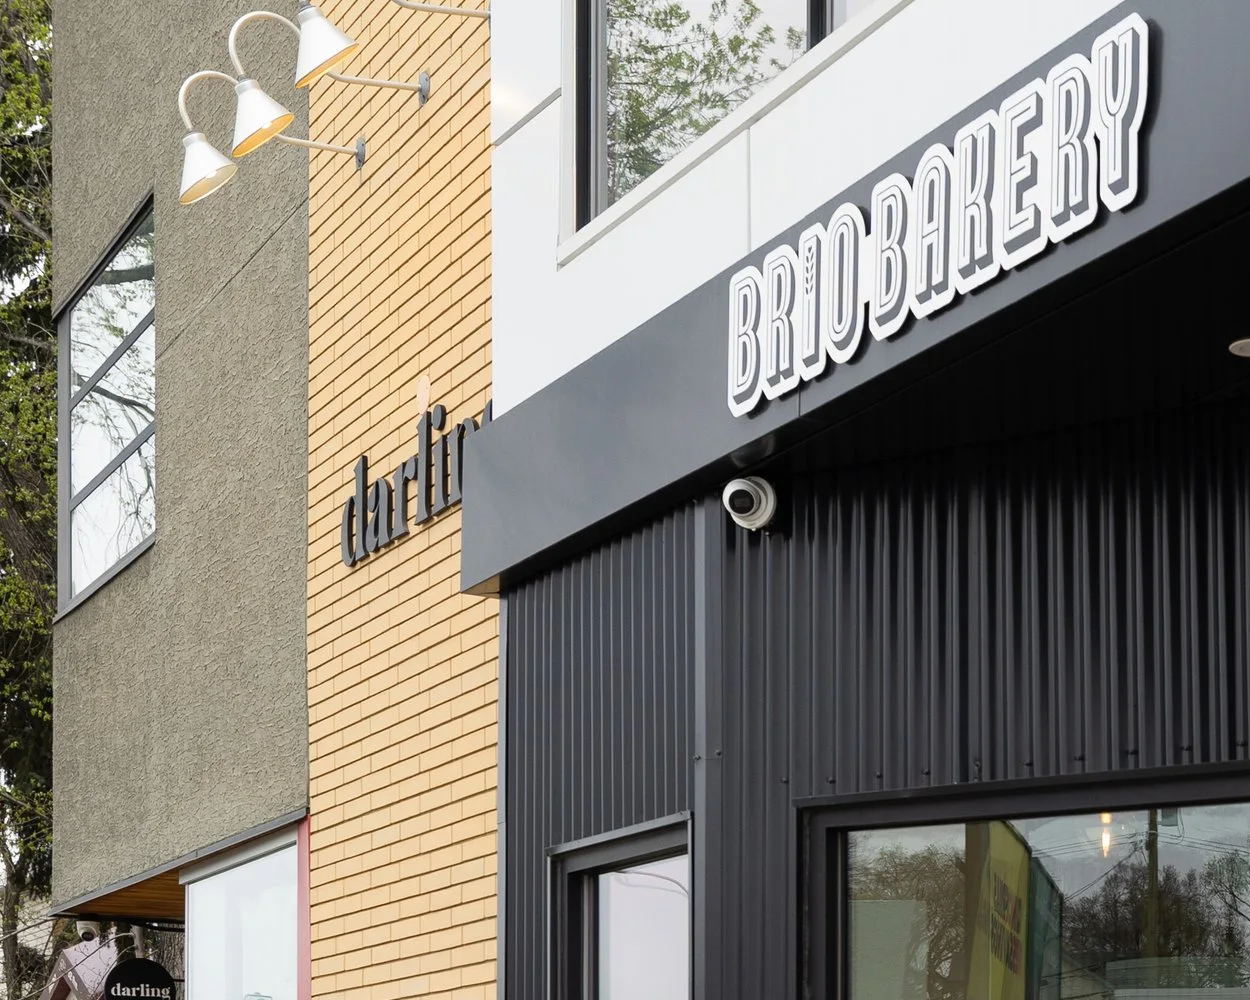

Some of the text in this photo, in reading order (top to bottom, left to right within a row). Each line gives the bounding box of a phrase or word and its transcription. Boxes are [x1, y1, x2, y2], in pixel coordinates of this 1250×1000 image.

[727, 12, 1148, 417] BRIO BAKERY
[341, 398, 492, 567] darlin
[111, 983, 171, 1000] darling
